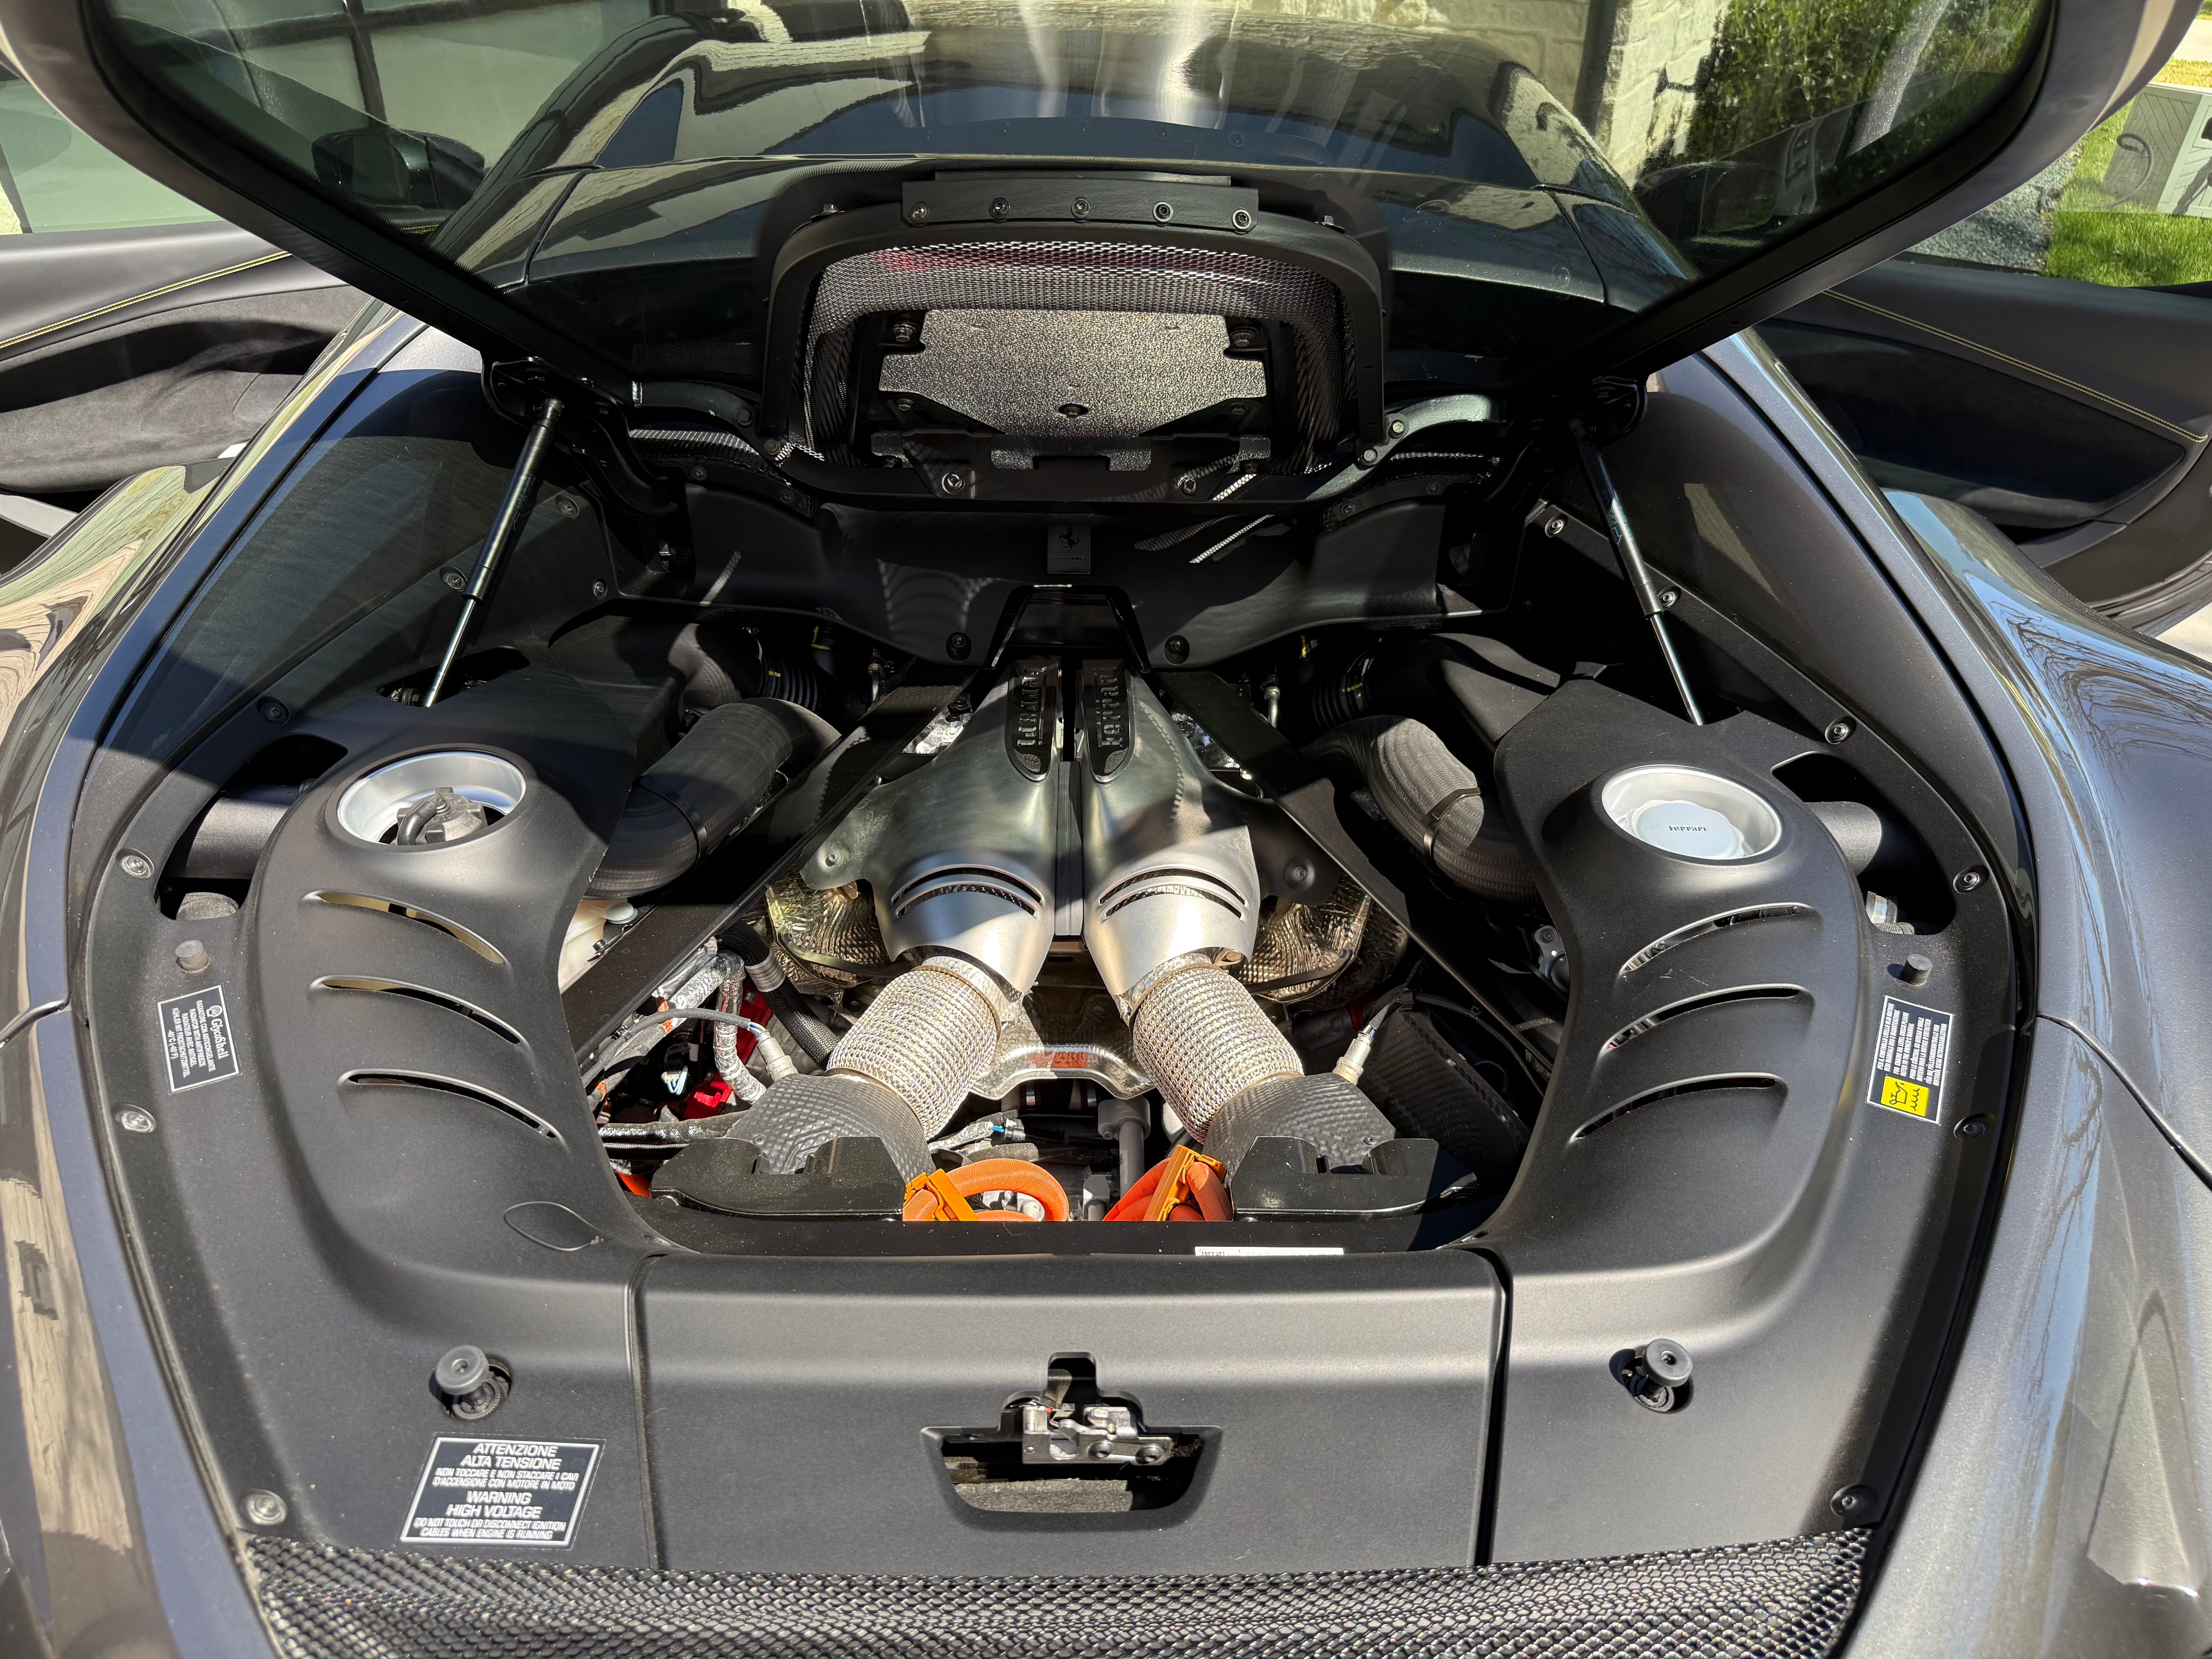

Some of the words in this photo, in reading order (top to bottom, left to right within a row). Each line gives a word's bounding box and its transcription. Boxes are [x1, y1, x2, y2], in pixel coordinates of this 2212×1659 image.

[196, 1000, 206, 1024] RADIATORE
[200, 1023, 208, 1033] CON
[182, 1013, 192, 1036] RADIATEUR
[188, 1048, 197, 1067] ANTIGEL
[189, 1008, 199, 1029] RADIATOR
[196, 1041, 206, 1067] ANTIFREEZE
[210, 1018, 229, 1059] GlycoShell
[177, 1032, 190, 1078] FROSTSCHUTZMITTEL
[203, 1033, 216, 1072] ANTICONGELANTE
[473, 1443, 556, 1457] ATTENZIONE
[460, 1455, 491, 1467] ALTA
[495, 1456, 562, 1470] TENSIONE
[435, 1468, 455, 1476] NON
[455, 1468, 490, 1477] TOCCARE
[489, 1470, 497, 1478] E
[496, 1470, 515, 1478] NON
[516, 1470, 555, 1480] STACCARE
[560, 1472, 579, 1481] CAVI
[432, 1477, 488, 1487] D'ACCENSIONE
[488, 1479, 506, 1488] CON
[506, 1479, 540, 1489] MOTORE
[540, 1480, 550, 1489] IN
[551, 1481, 575, 1490] MOTO
[467, 1491, 532, 1504] WARNING
[446, 1504, 482, 1517] HIGH
[484, 1505, 543, 1519] VOLTAGE
[413, 1517, 428, 1527] DO
[426, 1518, 445, 1527] NOT
[445, 1518, 469, 1528] TOUCH
[468, 1519, 483, 1528] OR
[483, 1519, 532, 1530] DISCONNECT
[531, 1521, 566, 1531] IGNITION
[420, 1527, 450, 1537] CABLES
[451, 1528, 476, 1537] WHEN
[476, 1529, 506, 1538] ENGINE
[505, 1529, 515, 1538] IS
[515, 1530, 555, 1539] RUNNING
